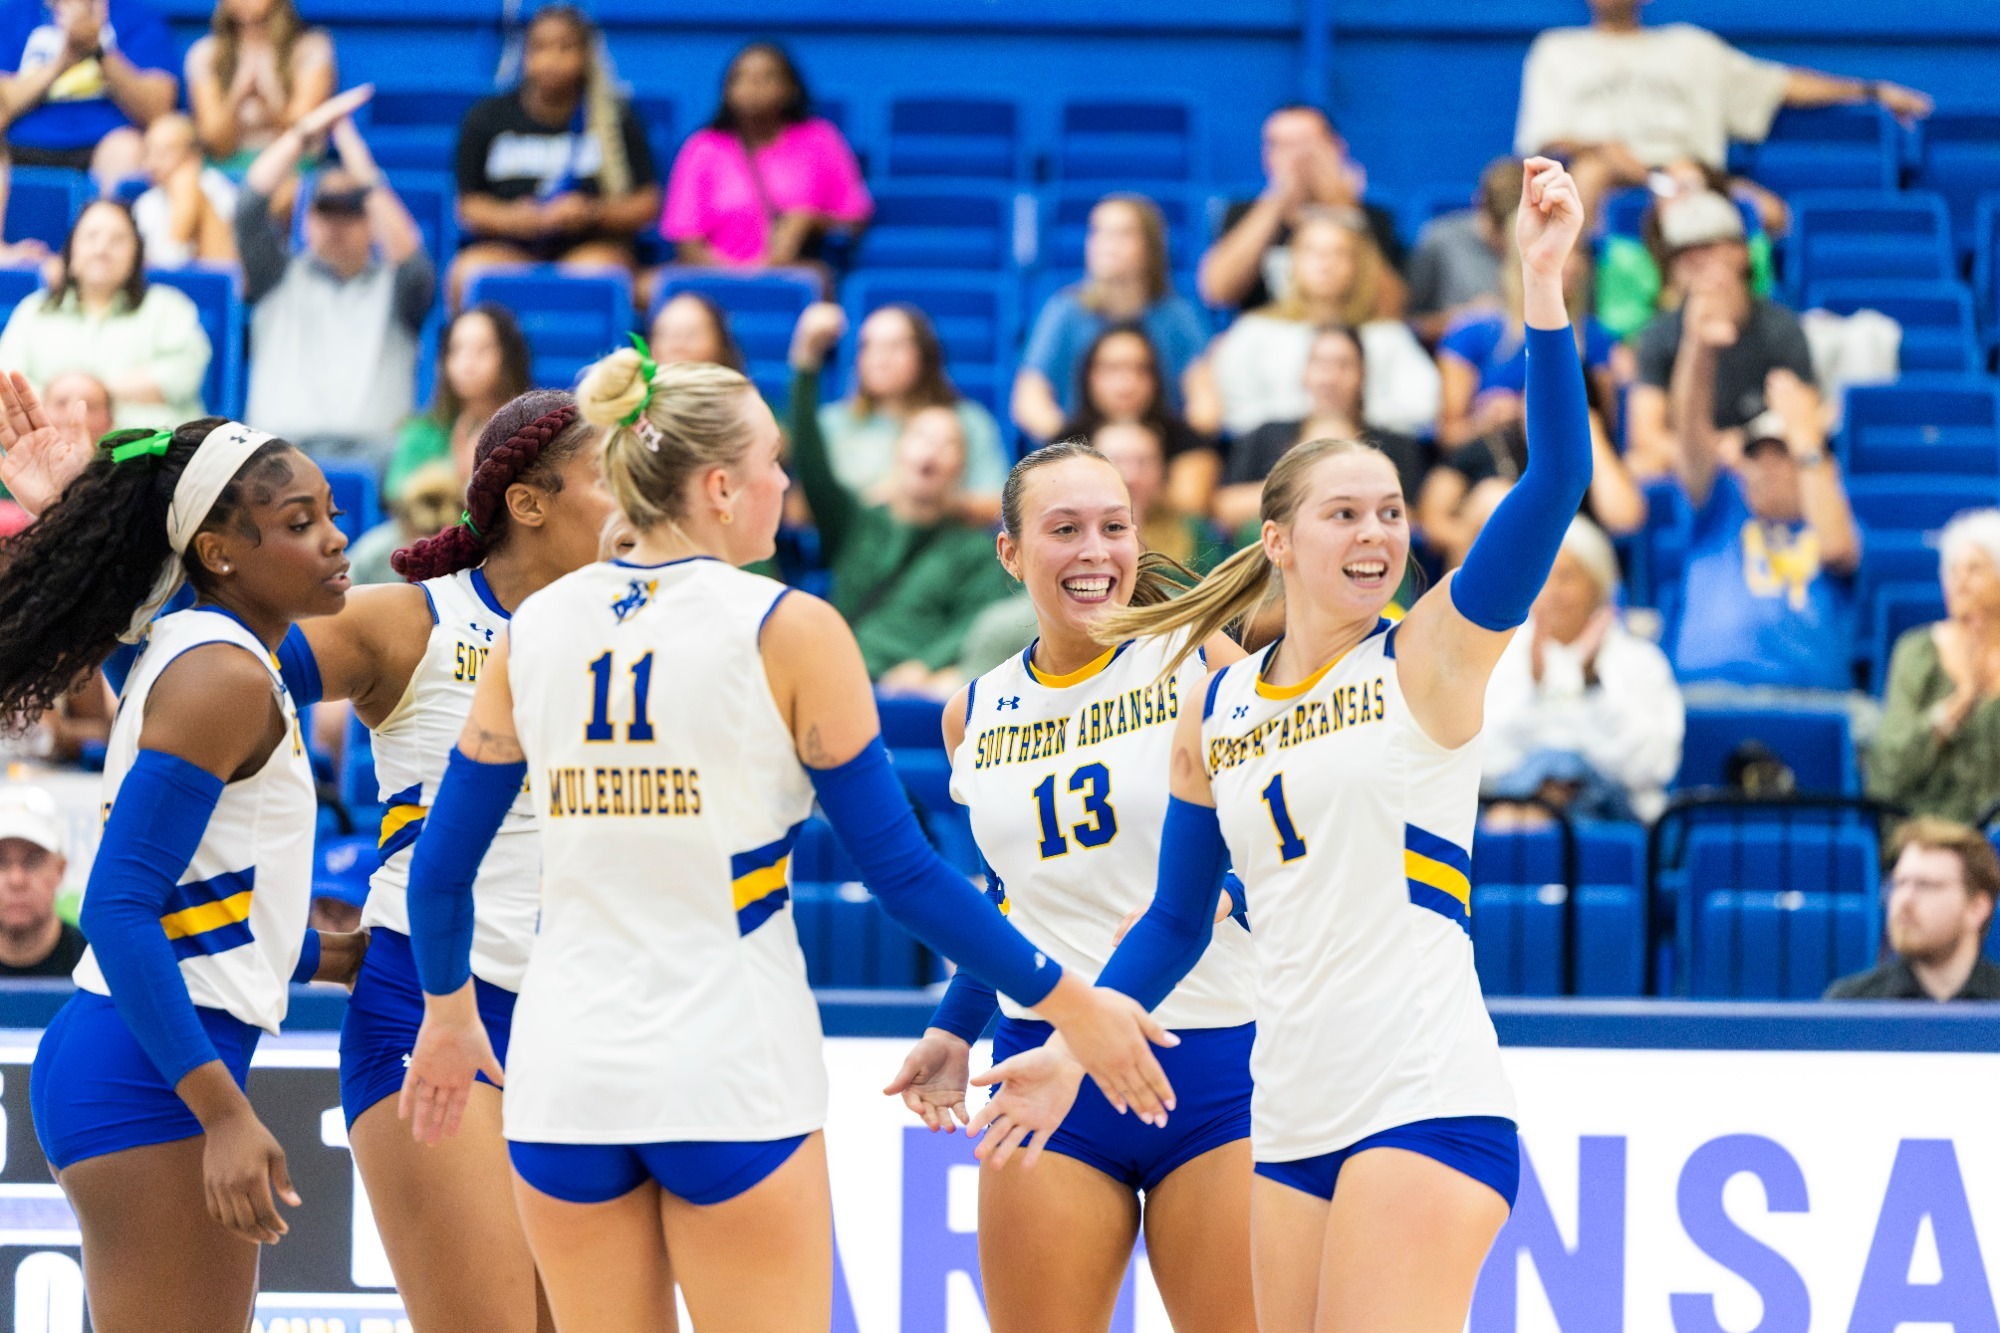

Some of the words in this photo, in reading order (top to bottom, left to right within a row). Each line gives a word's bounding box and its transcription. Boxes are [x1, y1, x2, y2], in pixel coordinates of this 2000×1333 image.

[584, 649, 656, 743] 11
[975, 716, 1070, 770] SOUTHERN
[1077, 675, 1179, 747] ARKANSAS
[548, 767, 702, 818] MULERIDERS
[1031, 760, 1119, 861] 13
[1260, 770, 1307, 864] 1
